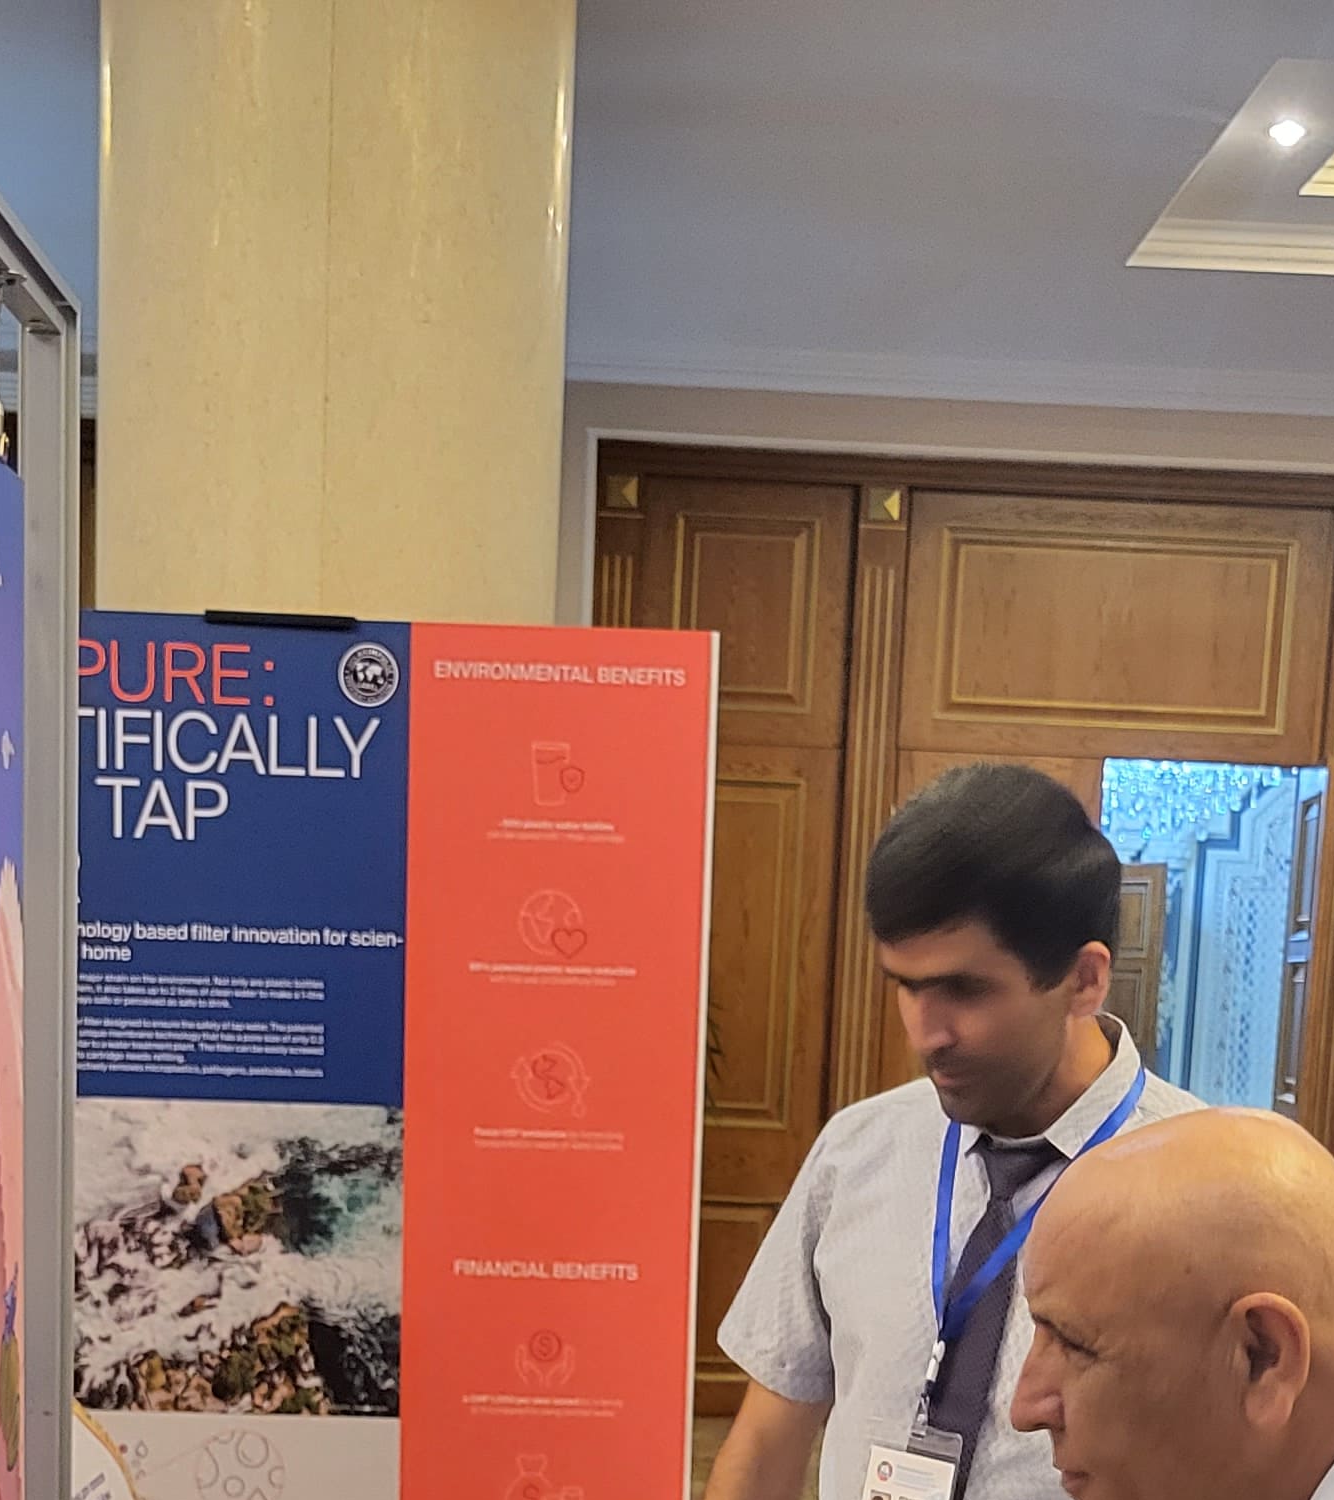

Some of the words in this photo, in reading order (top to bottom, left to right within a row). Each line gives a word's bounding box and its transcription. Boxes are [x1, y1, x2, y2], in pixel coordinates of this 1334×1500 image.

[434, 660, 594, 684] ENVIRONMENTAL
[597, 664, 686, 687] BENEFITS
[94, 775, 229, 841] TAP
[78, 920, 131, 944] nology
[134, 921, 188, 941] based
[191, 922, 231, 942] filter
[232, 924, 320, 945] innovation
[322, 926, 348, 946] for
[82, 943, 131, 961] home
[453, 1258, 550, 1279] FINANCIAL
[552, 1261, 639, 1281] BENEFITS
